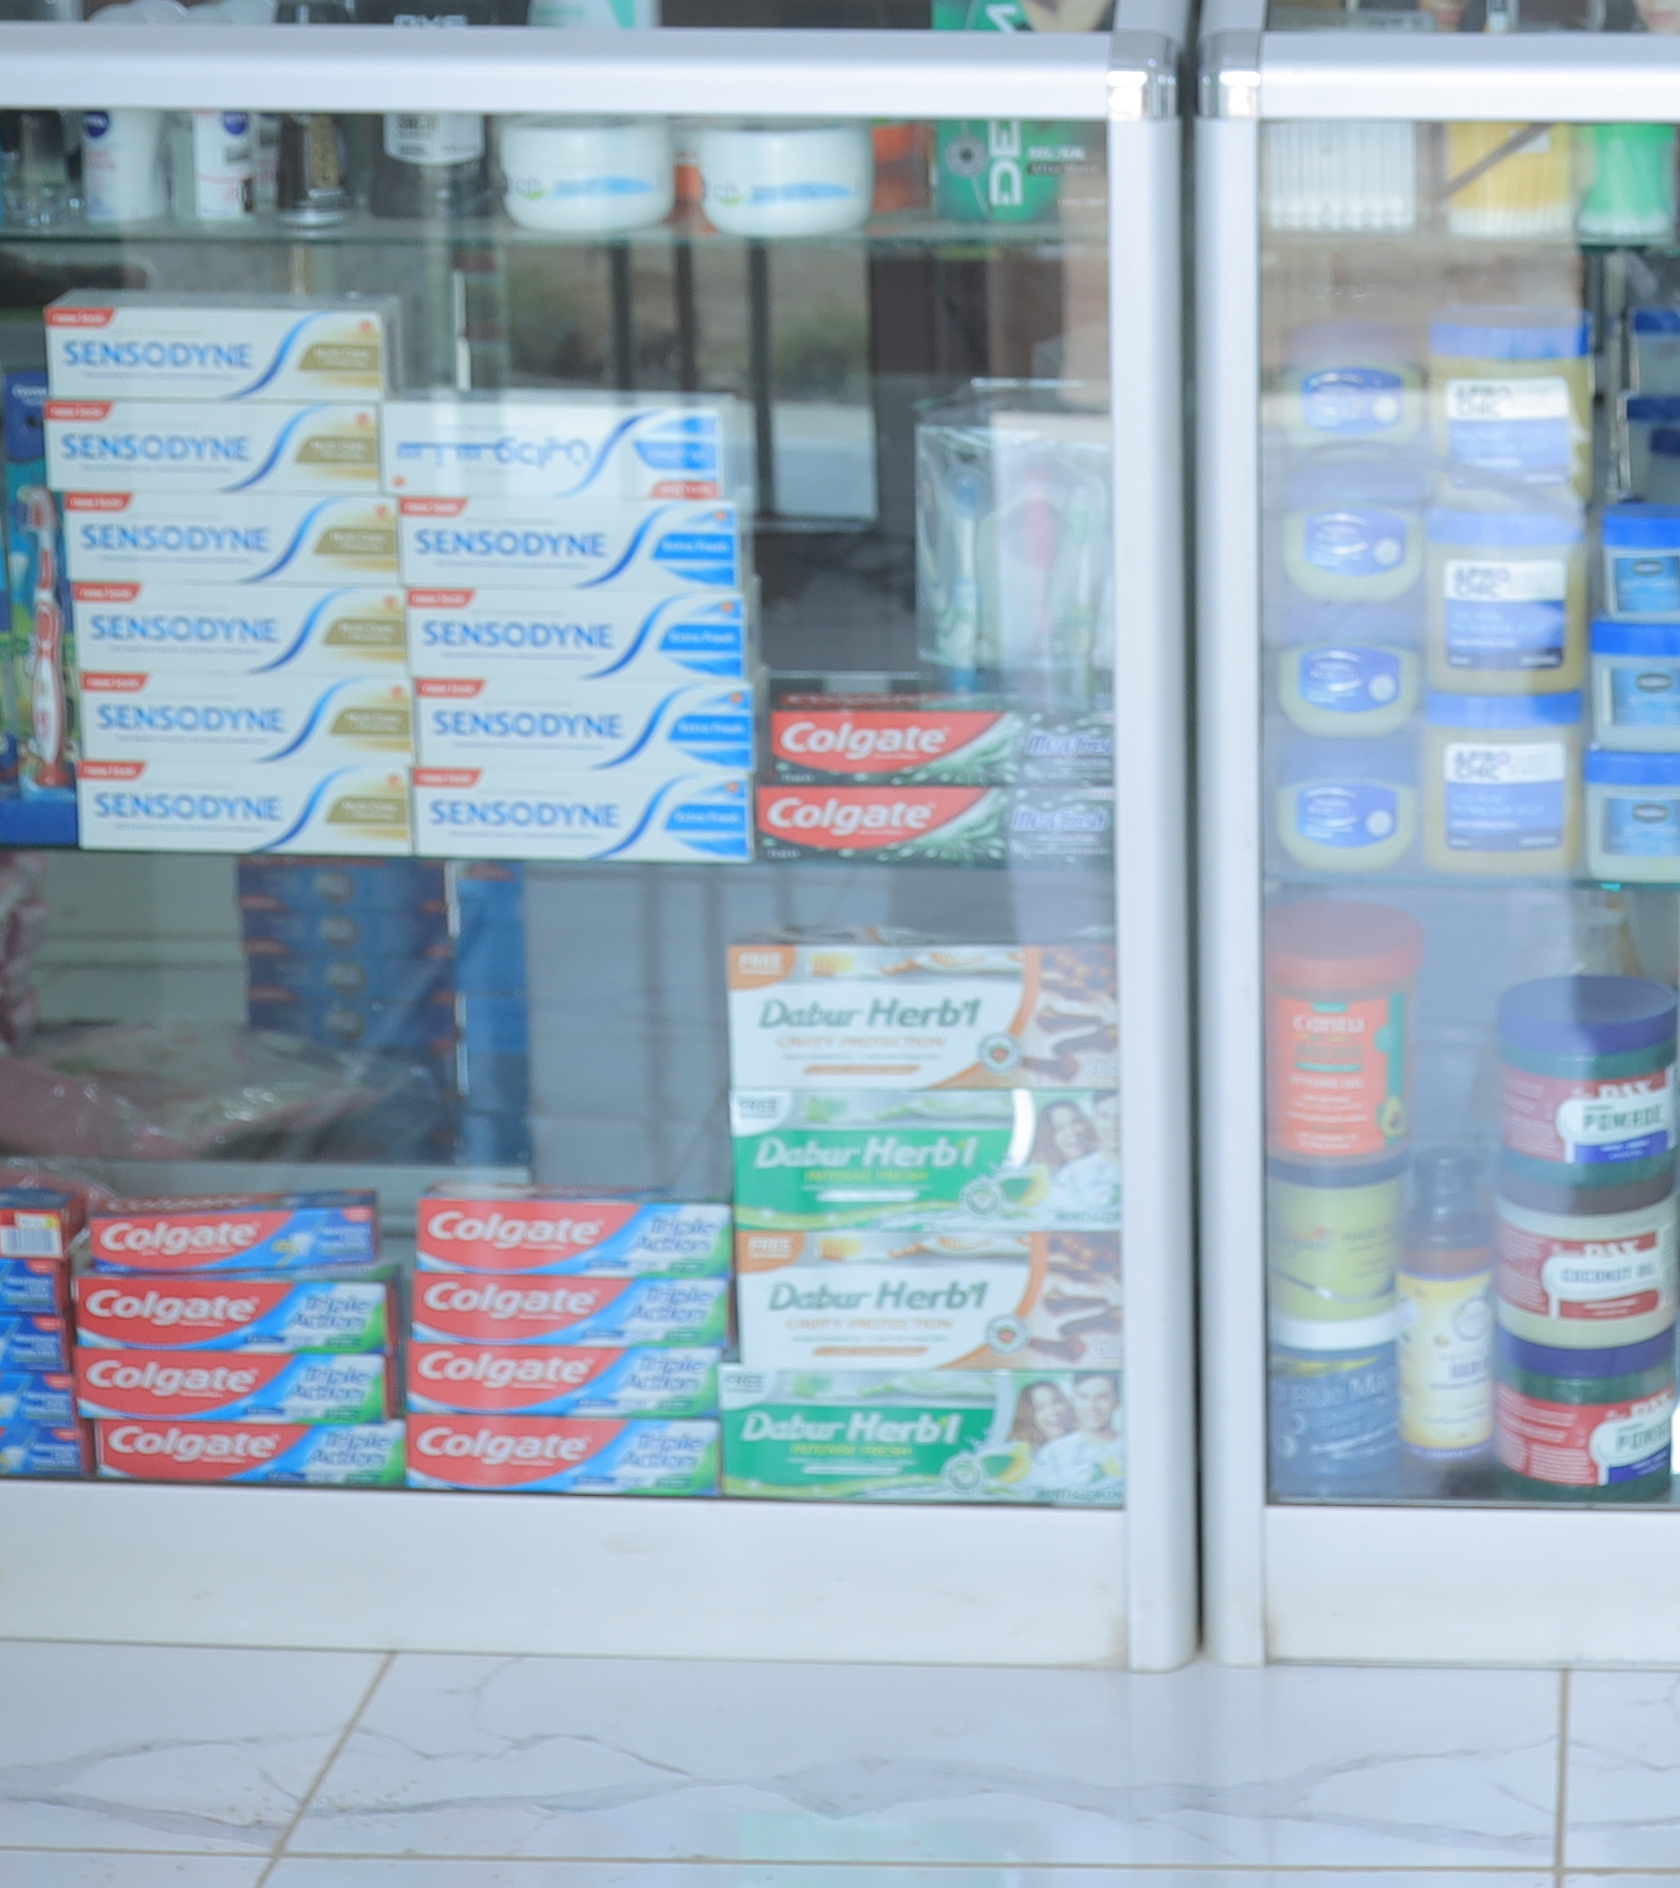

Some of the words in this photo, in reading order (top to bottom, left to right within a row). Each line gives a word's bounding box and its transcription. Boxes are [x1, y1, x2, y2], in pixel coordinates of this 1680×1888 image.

[62, 340, 254, 369] SENSODYNE
[60, 434, 250, 462] SENSODYNE
[80, 525, 271, 553] SENSODYNE
[414, 530, 607, 558] SENSODYNE
[88, 615, 280, 643] SENSODYNE
[421, 620, 614, 649] SENSODYNE
[96, 703, 287, 733] SENSODYNE
[432, 711, 624, 740] SENSODYNE
[781, 721, 948, 762] Colgate
[92, 792, 282, 821] SENSODYNE
[429, 800, 621, 829] SENSODYNE
[767, 796, 933, 835] Colgate
[758, 998, 862, 1029] Dabur
[754, 1136, 860, 1170] Dabur
[99, 1220, 260, 1257] Colgate
[425, 1210, 602, 1249] Colgate
[85, 1287, 257, 1329] Colgate
[422, 1280, 601, 1322] Colgate
[768, 1280, 872, 1312] Dabur
[85, 1357, 257, 1397] Colgate
[416, 1350, 594, 1391] Colgate
[741, 1414, 845, 1444] Dabur
[107, 1425, 280, 1465] Colgate
[415, 1425, 590, 1466] Colgate
